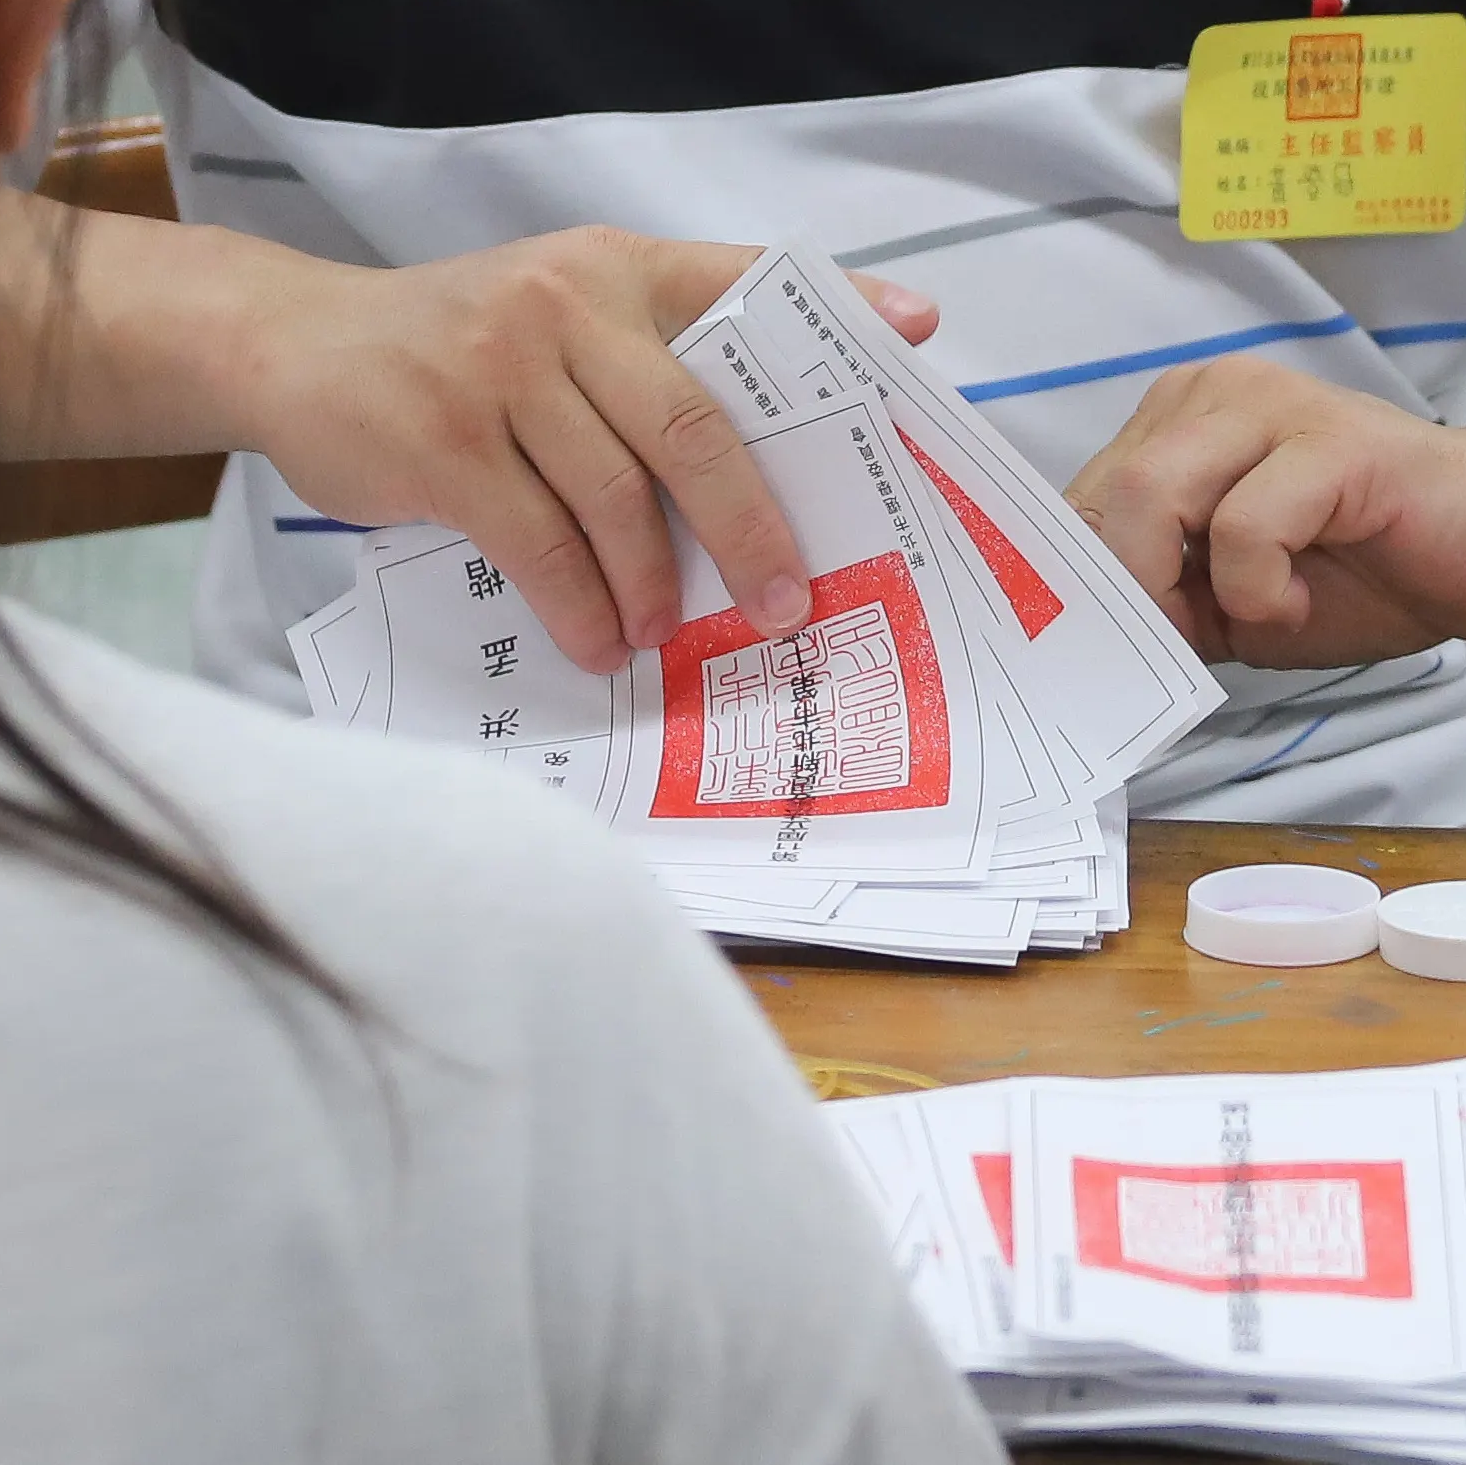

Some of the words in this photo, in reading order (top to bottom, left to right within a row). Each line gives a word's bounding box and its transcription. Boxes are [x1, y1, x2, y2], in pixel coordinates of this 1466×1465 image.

[1280, 124, 1427, 159] 主任監察員
[1212, 207, 1290, 231] 000293
[850, 427, 926, 570] 新北市選舉委員會
[464, 557, 520, 740] 洪孟楷
